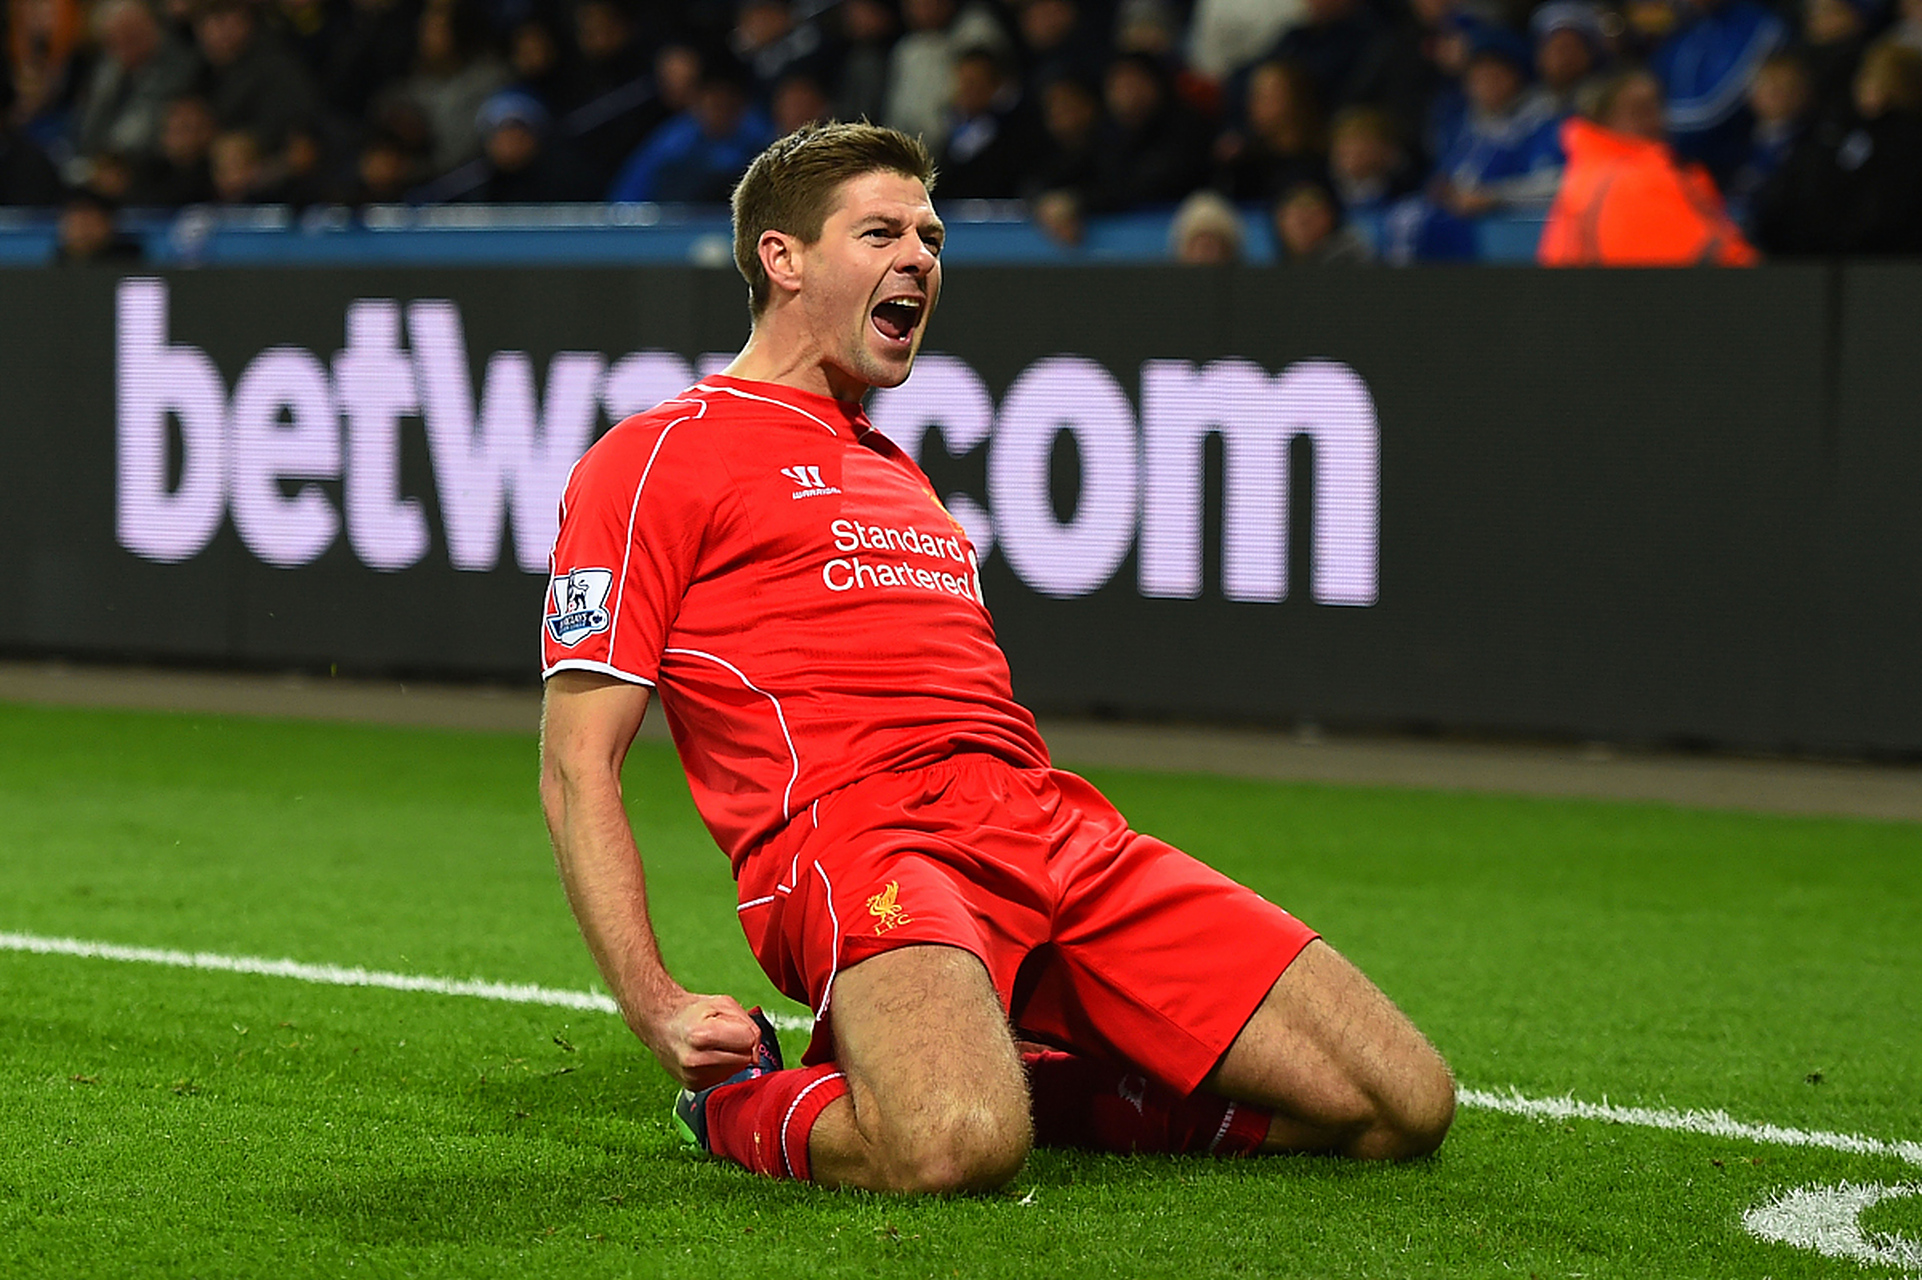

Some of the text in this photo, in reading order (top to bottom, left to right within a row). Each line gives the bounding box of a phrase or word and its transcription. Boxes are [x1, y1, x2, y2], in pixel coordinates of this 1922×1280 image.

[116, 277, 1380, 606] betwcom
[831, 519, 965, 563] Standard
[822, 557, 974, 601] Chartered
[874, 913, 915, 936] LFC
